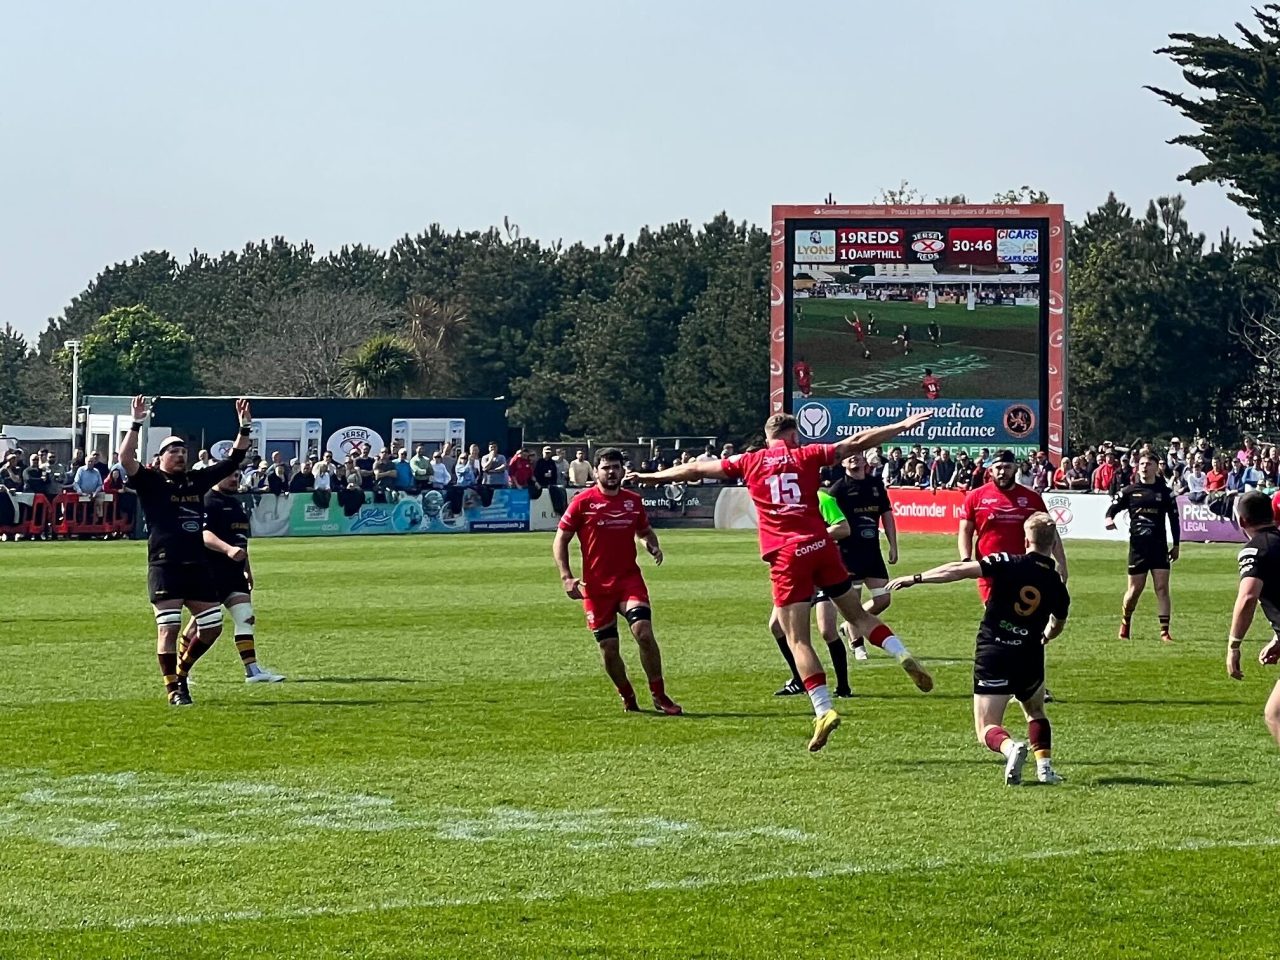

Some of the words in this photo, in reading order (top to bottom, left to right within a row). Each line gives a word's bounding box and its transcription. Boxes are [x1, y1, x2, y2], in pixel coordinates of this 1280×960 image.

[840, 233, 857, 243] 19
[857, 231, 899, 244] REDS
[912, 231, 943, 240] JERSEY
[797, 245, 834, 254] LYONS
[952, 240, 992, 251] 30:46
[840, 249, 857, 260] 10
[857, 250, 901, 259] AMPTHILL
[917, 253, 939, 261] REDS
[847, 402, 873, 417] For
[876, 406, 902, 418] our
[341, 429, 370, 439] JERSEY
[927, 422, 995, 440] guidance
[765, 473, 802, 504] 15
[1048, 497, 1071, 507] JERSEY
[893, 501, 946, 517] Santander
[1183, 504, 1239, 521] PRES
[1183, 521, 1209, 532] LEGAL
[1014, 585, 1041, 617] 9
